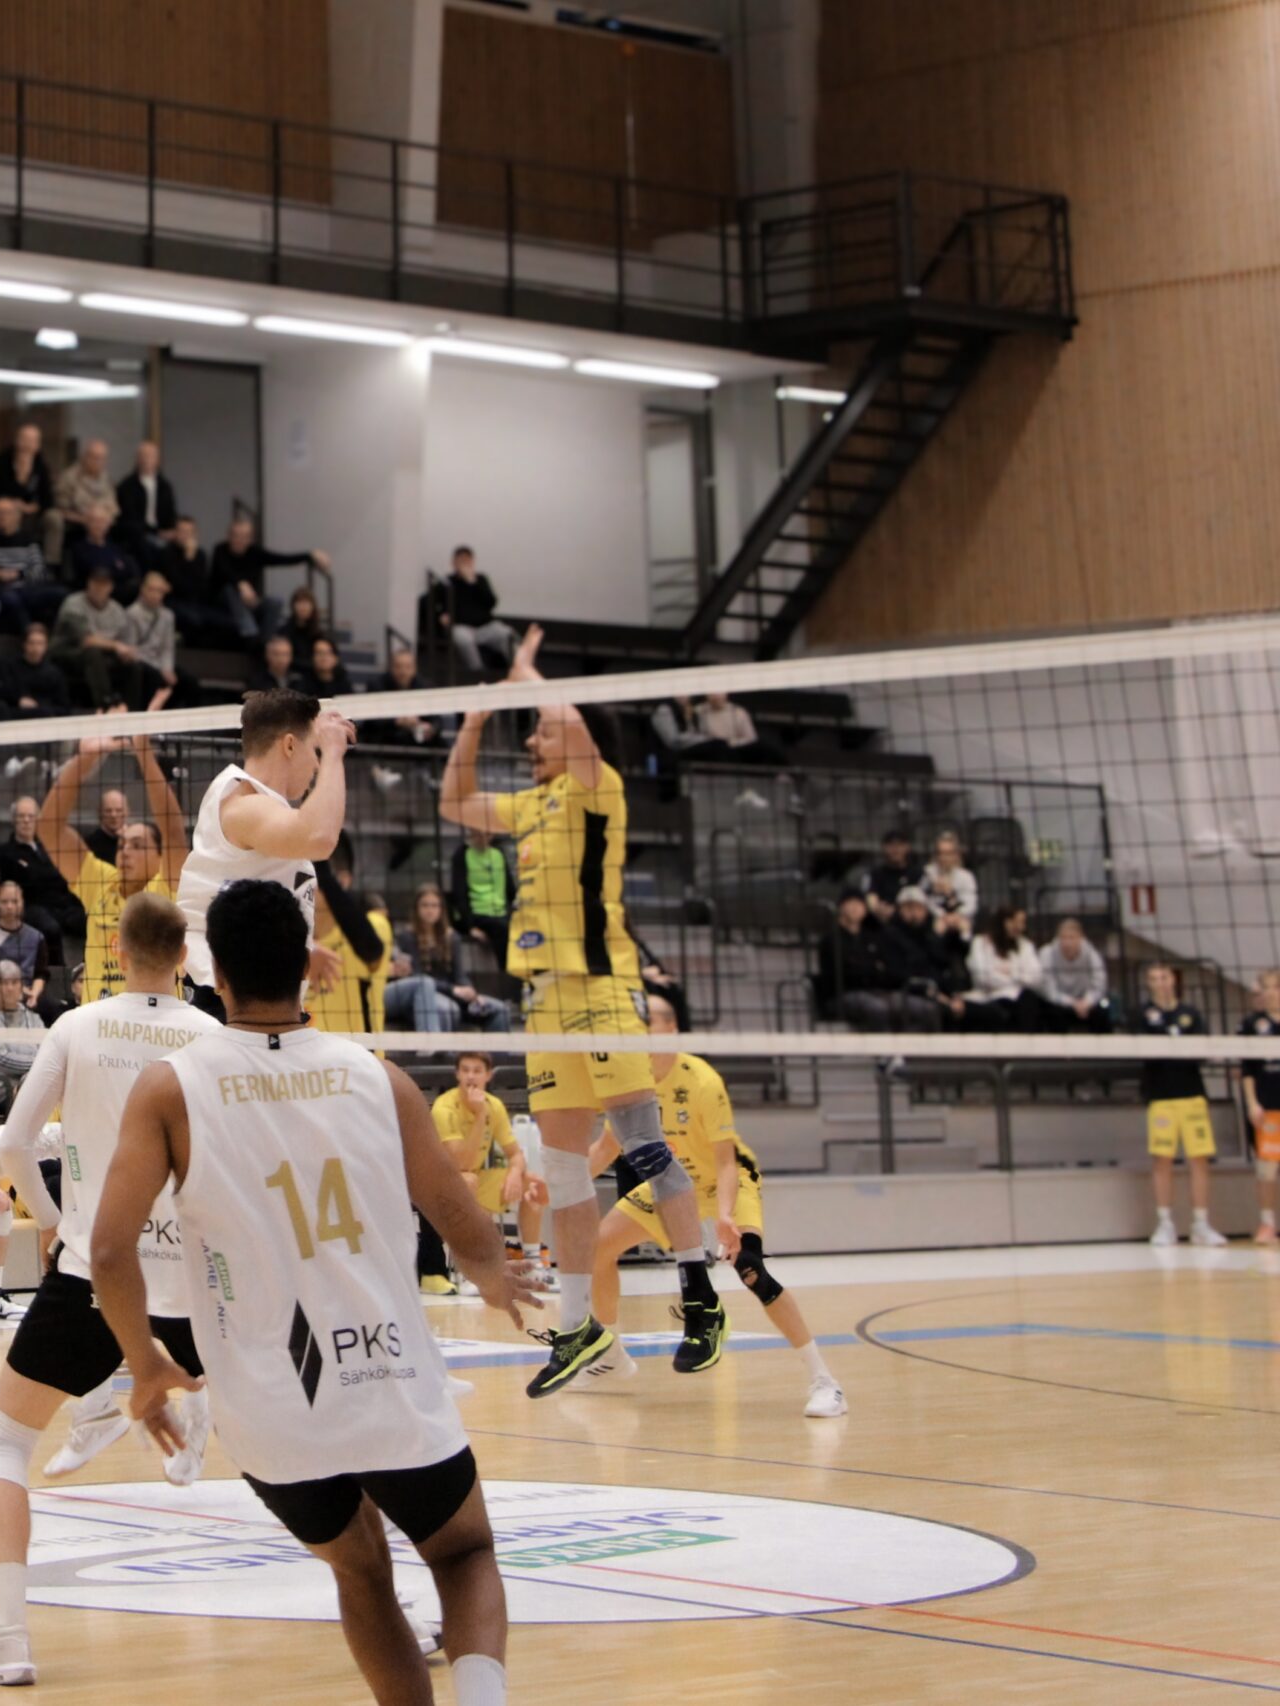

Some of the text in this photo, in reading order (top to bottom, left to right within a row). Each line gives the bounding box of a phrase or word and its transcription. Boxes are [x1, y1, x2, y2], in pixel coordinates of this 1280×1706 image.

[98, 1019, 203, 1050] HAAPAKOSK
[218, 1067, 353, 1105] FERNANDEZ
[527, 1069, 555, 1085] auta
[265, 1157, 365, 1260] 14
[332, 1322, 401, 1364] PKS
